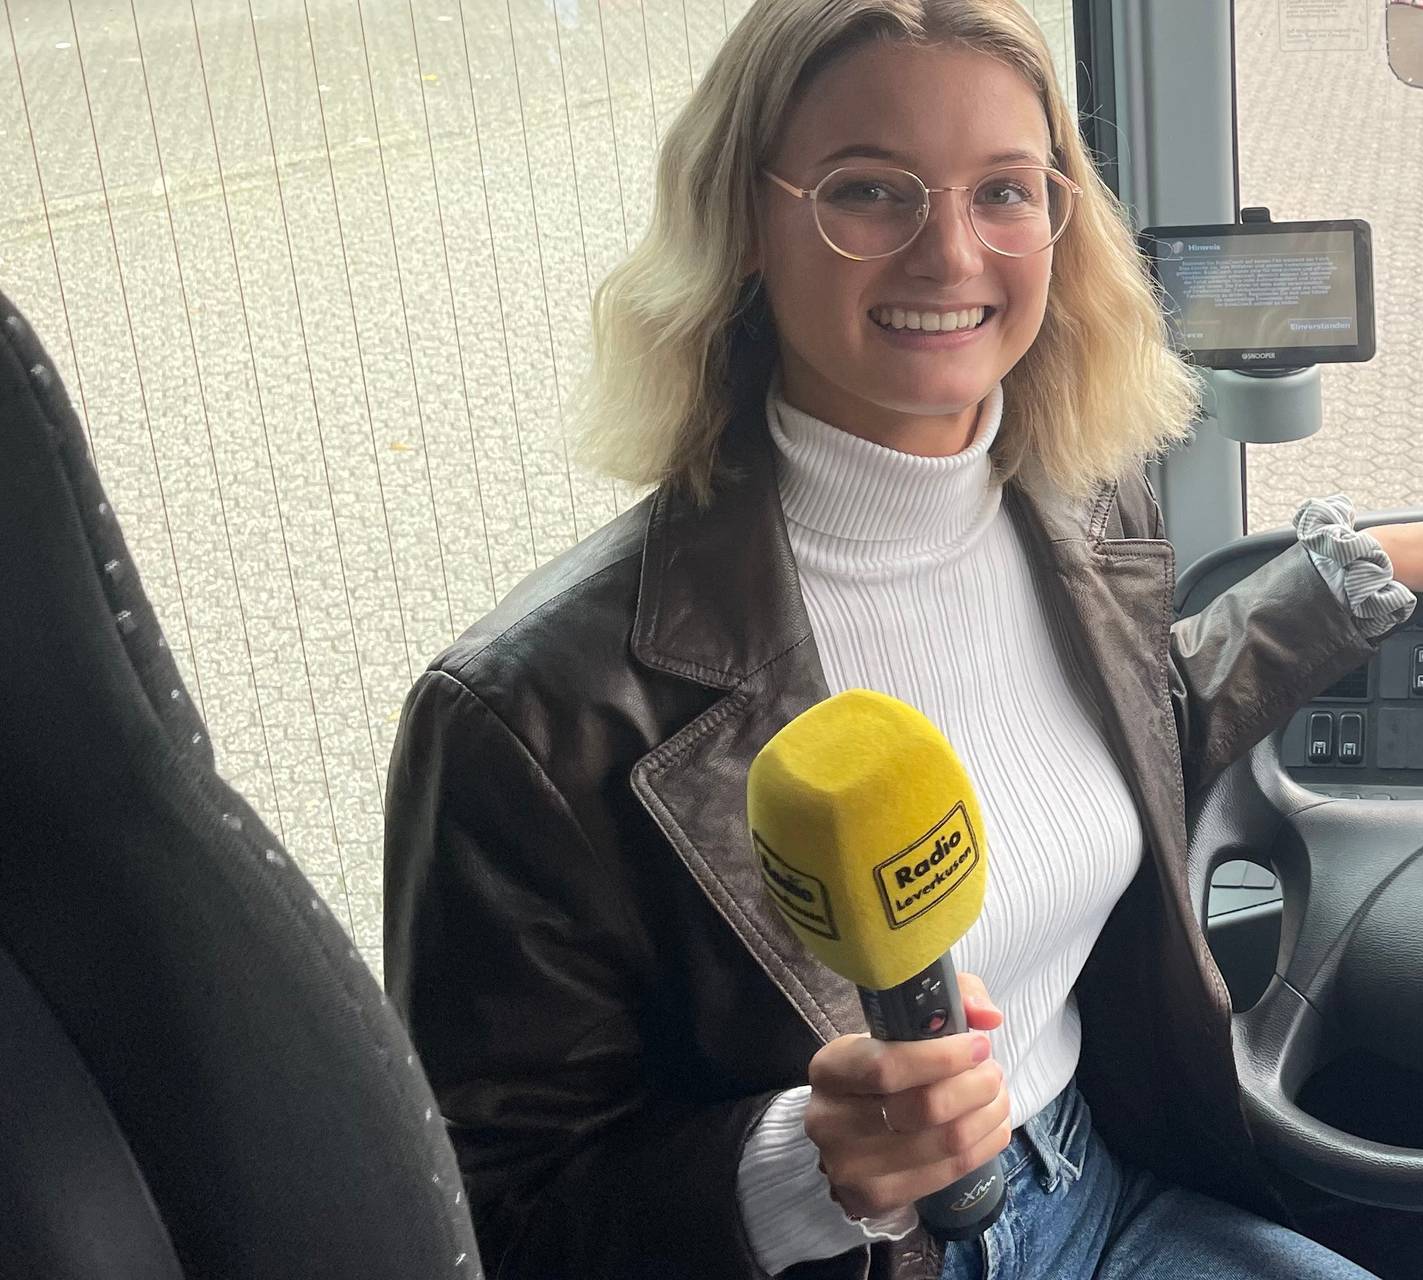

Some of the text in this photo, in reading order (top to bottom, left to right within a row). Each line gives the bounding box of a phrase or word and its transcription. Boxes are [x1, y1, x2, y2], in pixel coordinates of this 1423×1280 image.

[1290, 321, 1351, 330] Einverstanden
[895, 831, 961, 889] Radio
[896, 846, 972, 912] Leverkusen
